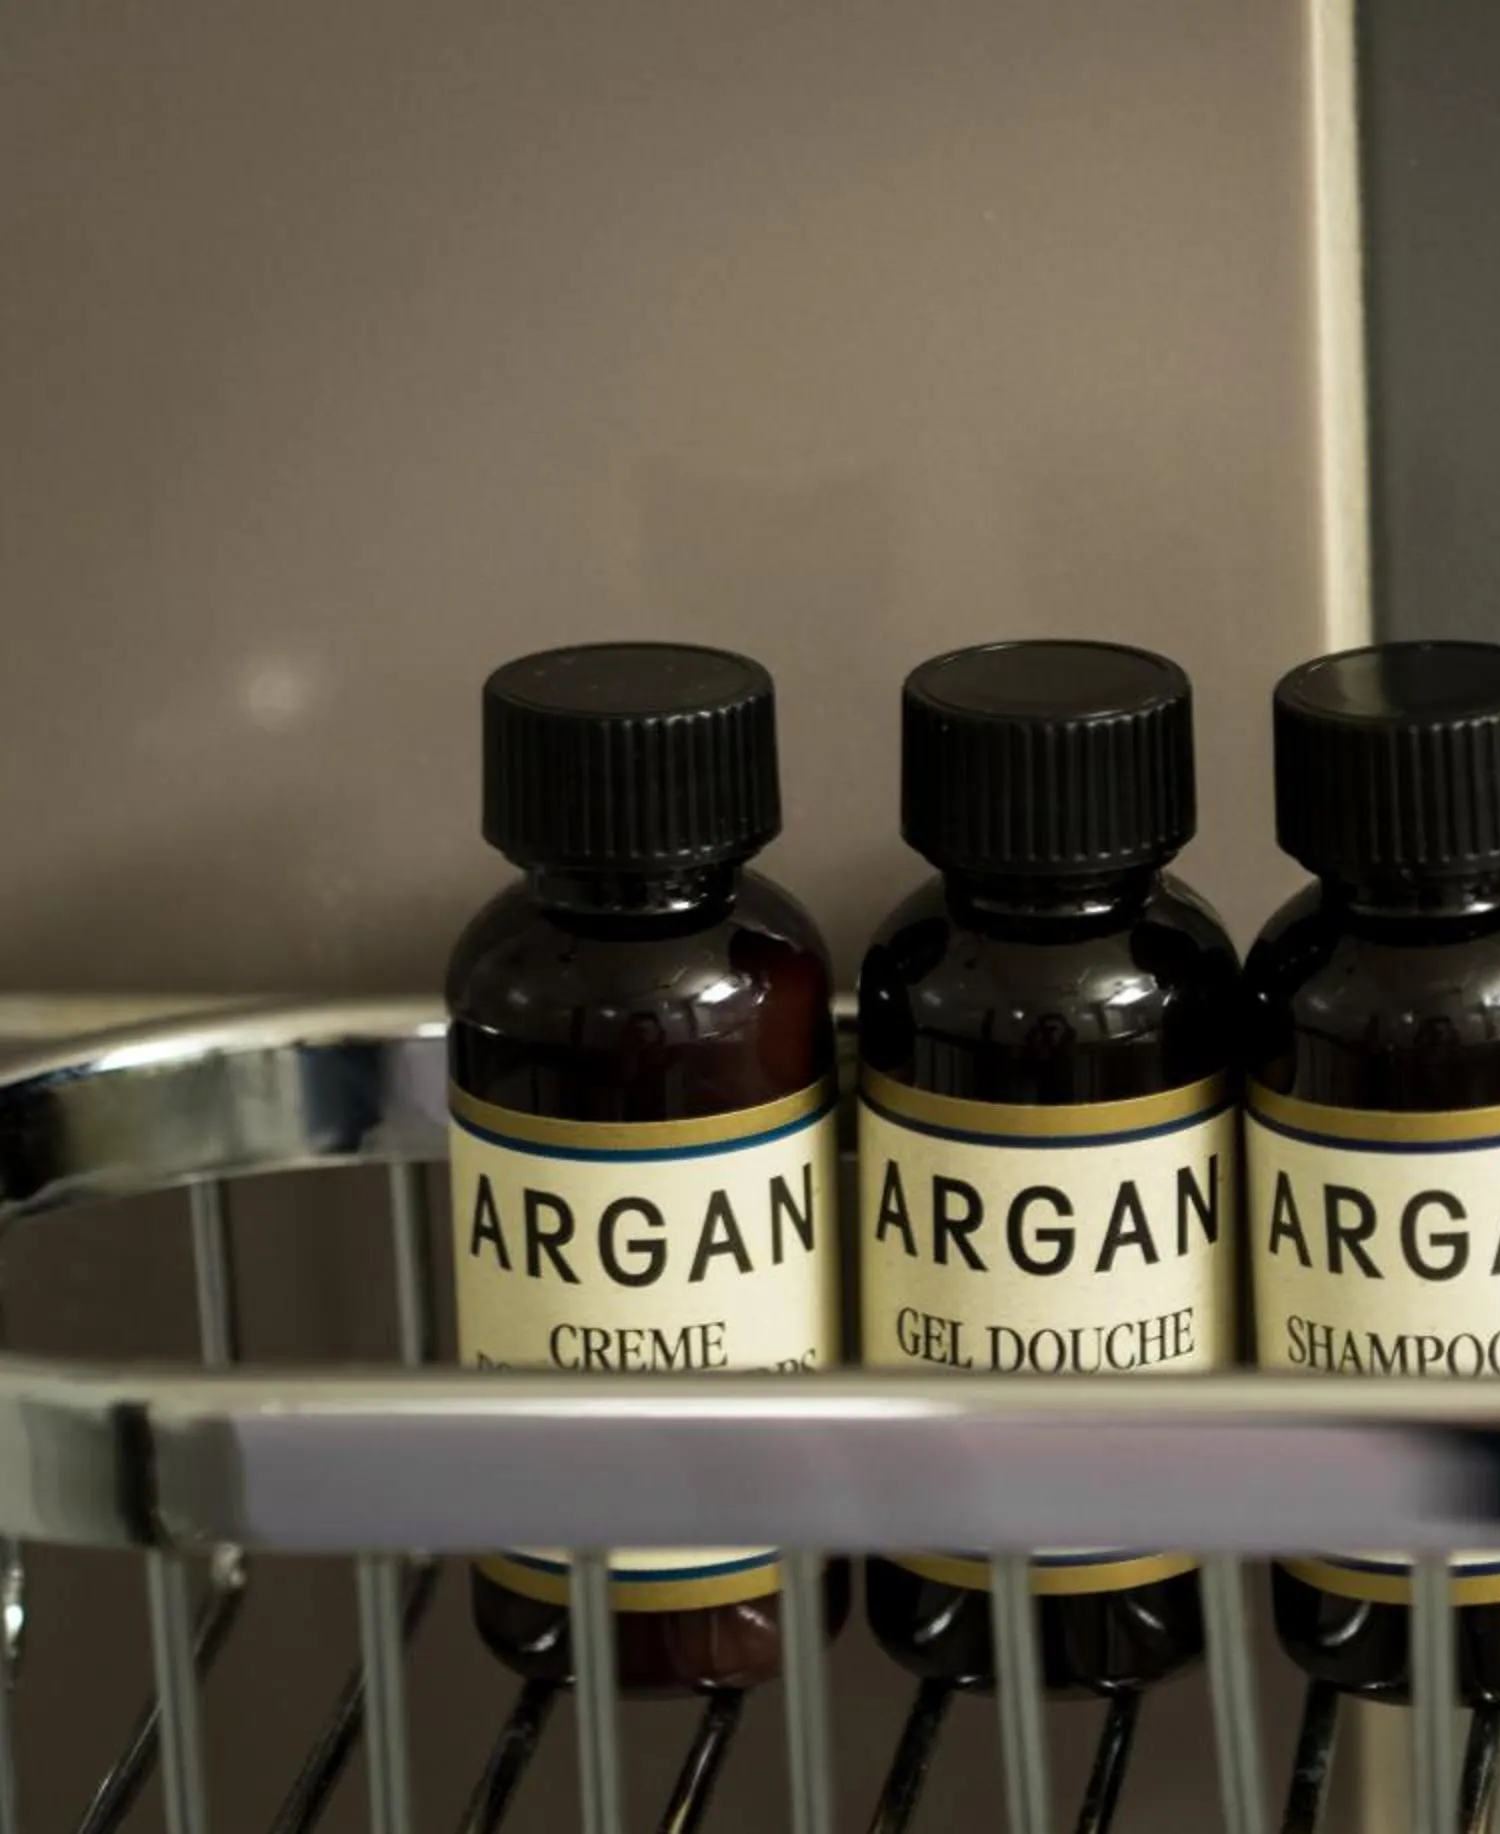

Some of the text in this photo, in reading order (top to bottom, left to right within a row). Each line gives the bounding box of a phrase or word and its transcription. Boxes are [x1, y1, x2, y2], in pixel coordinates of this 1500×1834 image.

[470, 1162, 816, 1288] ARGAN
[875, 1153, 1219, 1276] ARGAN
[549, 1320, 729, 1372] CREME
[896, 1306, 974, 1369] GEL
[985, 1306, 1195, 1374] DOUCHE
